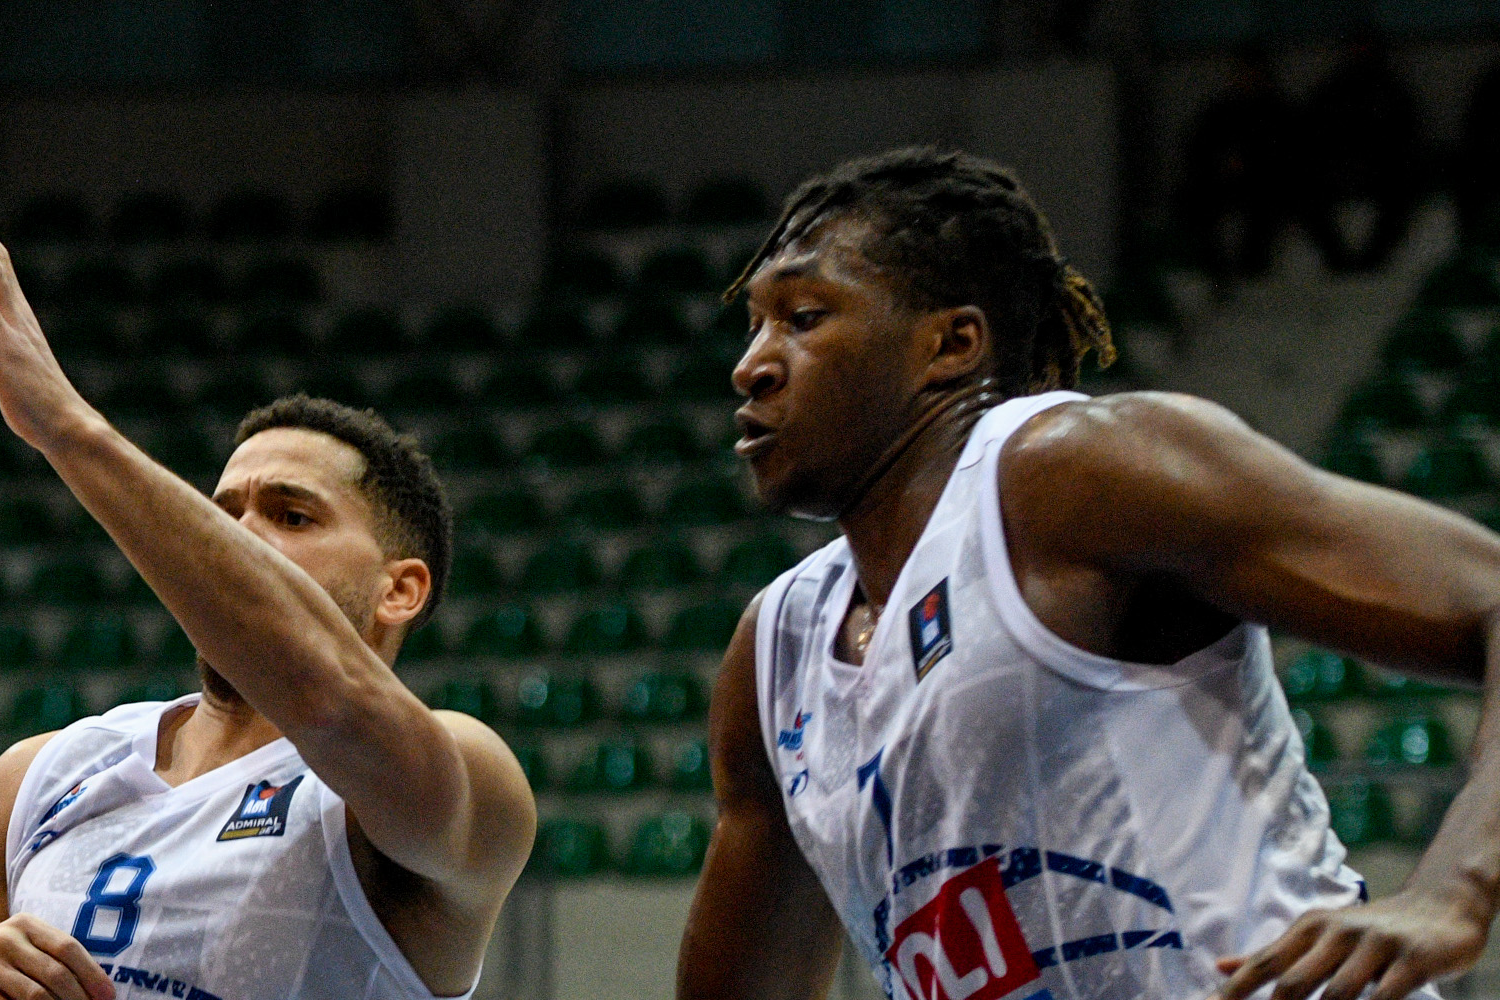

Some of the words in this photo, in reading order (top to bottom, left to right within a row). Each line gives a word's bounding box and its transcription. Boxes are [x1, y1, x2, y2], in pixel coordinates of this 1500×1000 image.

[243, 799, 270, 815] ABA
[225, 815, 282, 833] ADMIRAL
[70, 852, 158, 958] 8
